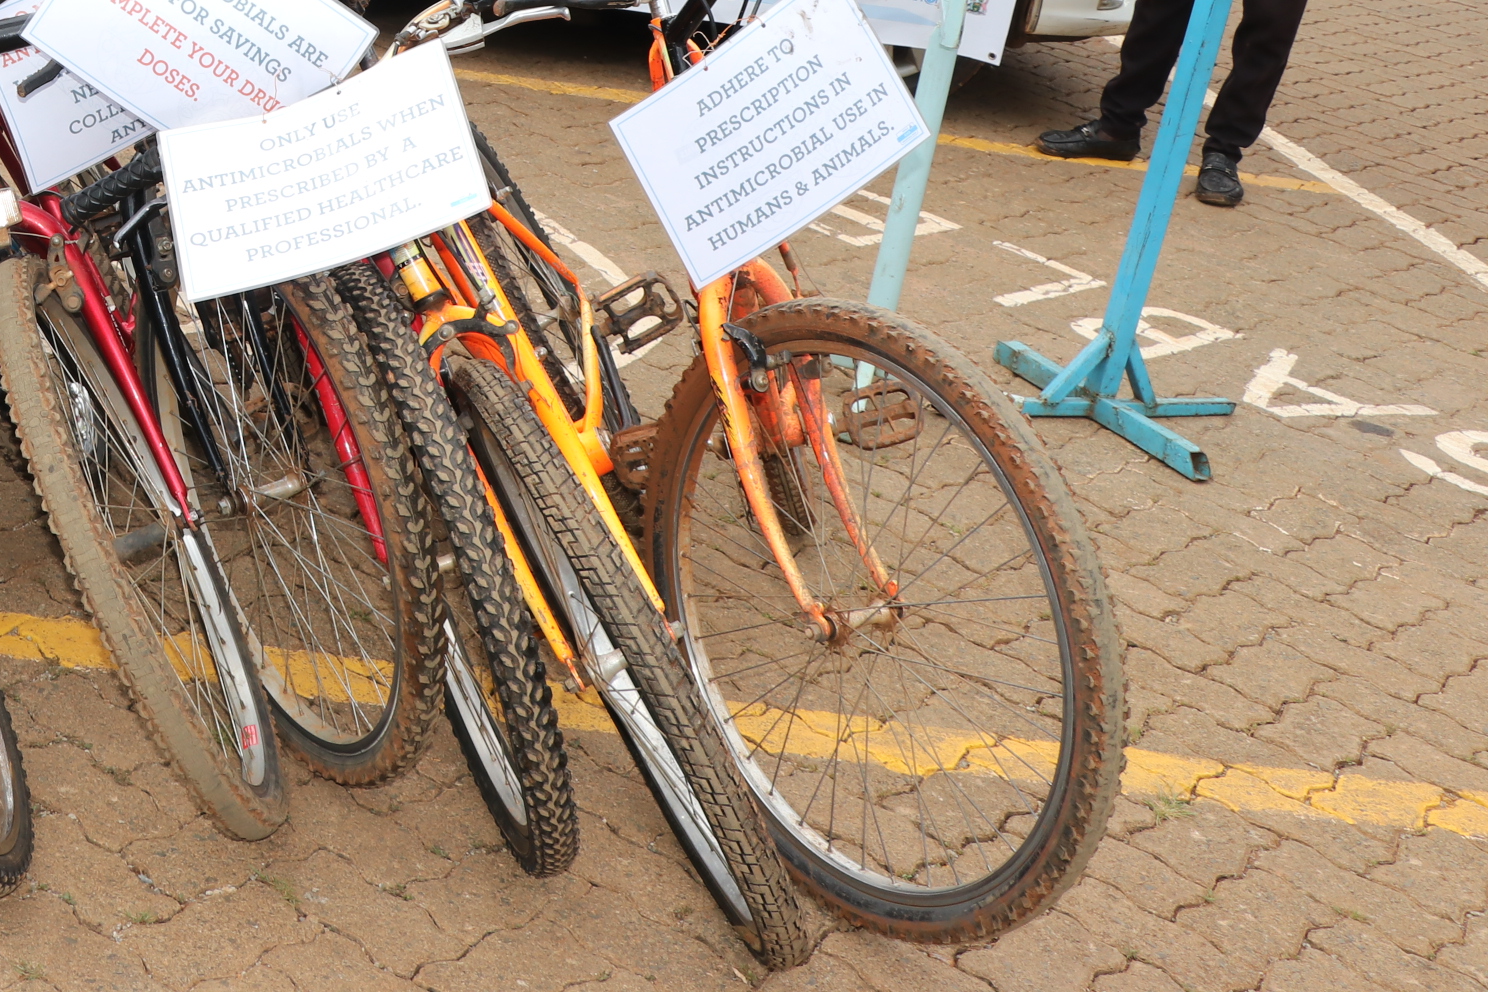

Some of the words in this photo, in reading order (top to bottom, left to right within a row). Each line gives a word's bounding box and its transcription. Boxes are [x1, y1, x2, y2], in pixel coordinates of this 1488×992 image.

[136, 48, 201, 102] DOSES.
[187, 41, 240, 88] YOUR
[209, 18, 292, 83] SAVINGS
[287, 34, 329, 69] ARE
[696, 57, 769, 117] ADHERE
[767, 38, 795, 65] TO
[259, 122, 317, 152] ONLY
[322, 102, 361, 130] USE
[694, 54, 824, 154] PRESCRIPTION
[694, 89, 830, 190] INSTRUCTIONS
[827, 72, 852, 98] IN
[182, 125, 372, 194] ANTIMICROBIALS
[376, 94, 446, 132] WHEN
[225, 161, 360, 213] PRESCRIBED
[364, 146, 389, 170] BY
[402, 136, 417, 153] A
[684, 126, 834, 232] ANTIMICROBIAL
[832, 99, 868, 131] USE
[866, 82, 889, 108] IN
[189, 205, 312, 248] QUALIFIED
[317, 145, 464, 216] HEALTHCARE
[707, 190, 794, 251] HUMANS
[795, 180, 810, 196] &
[811, 120, 895, 186] ANIMALS.
[246, 197, 422, 263] PROFESSIONAL.
